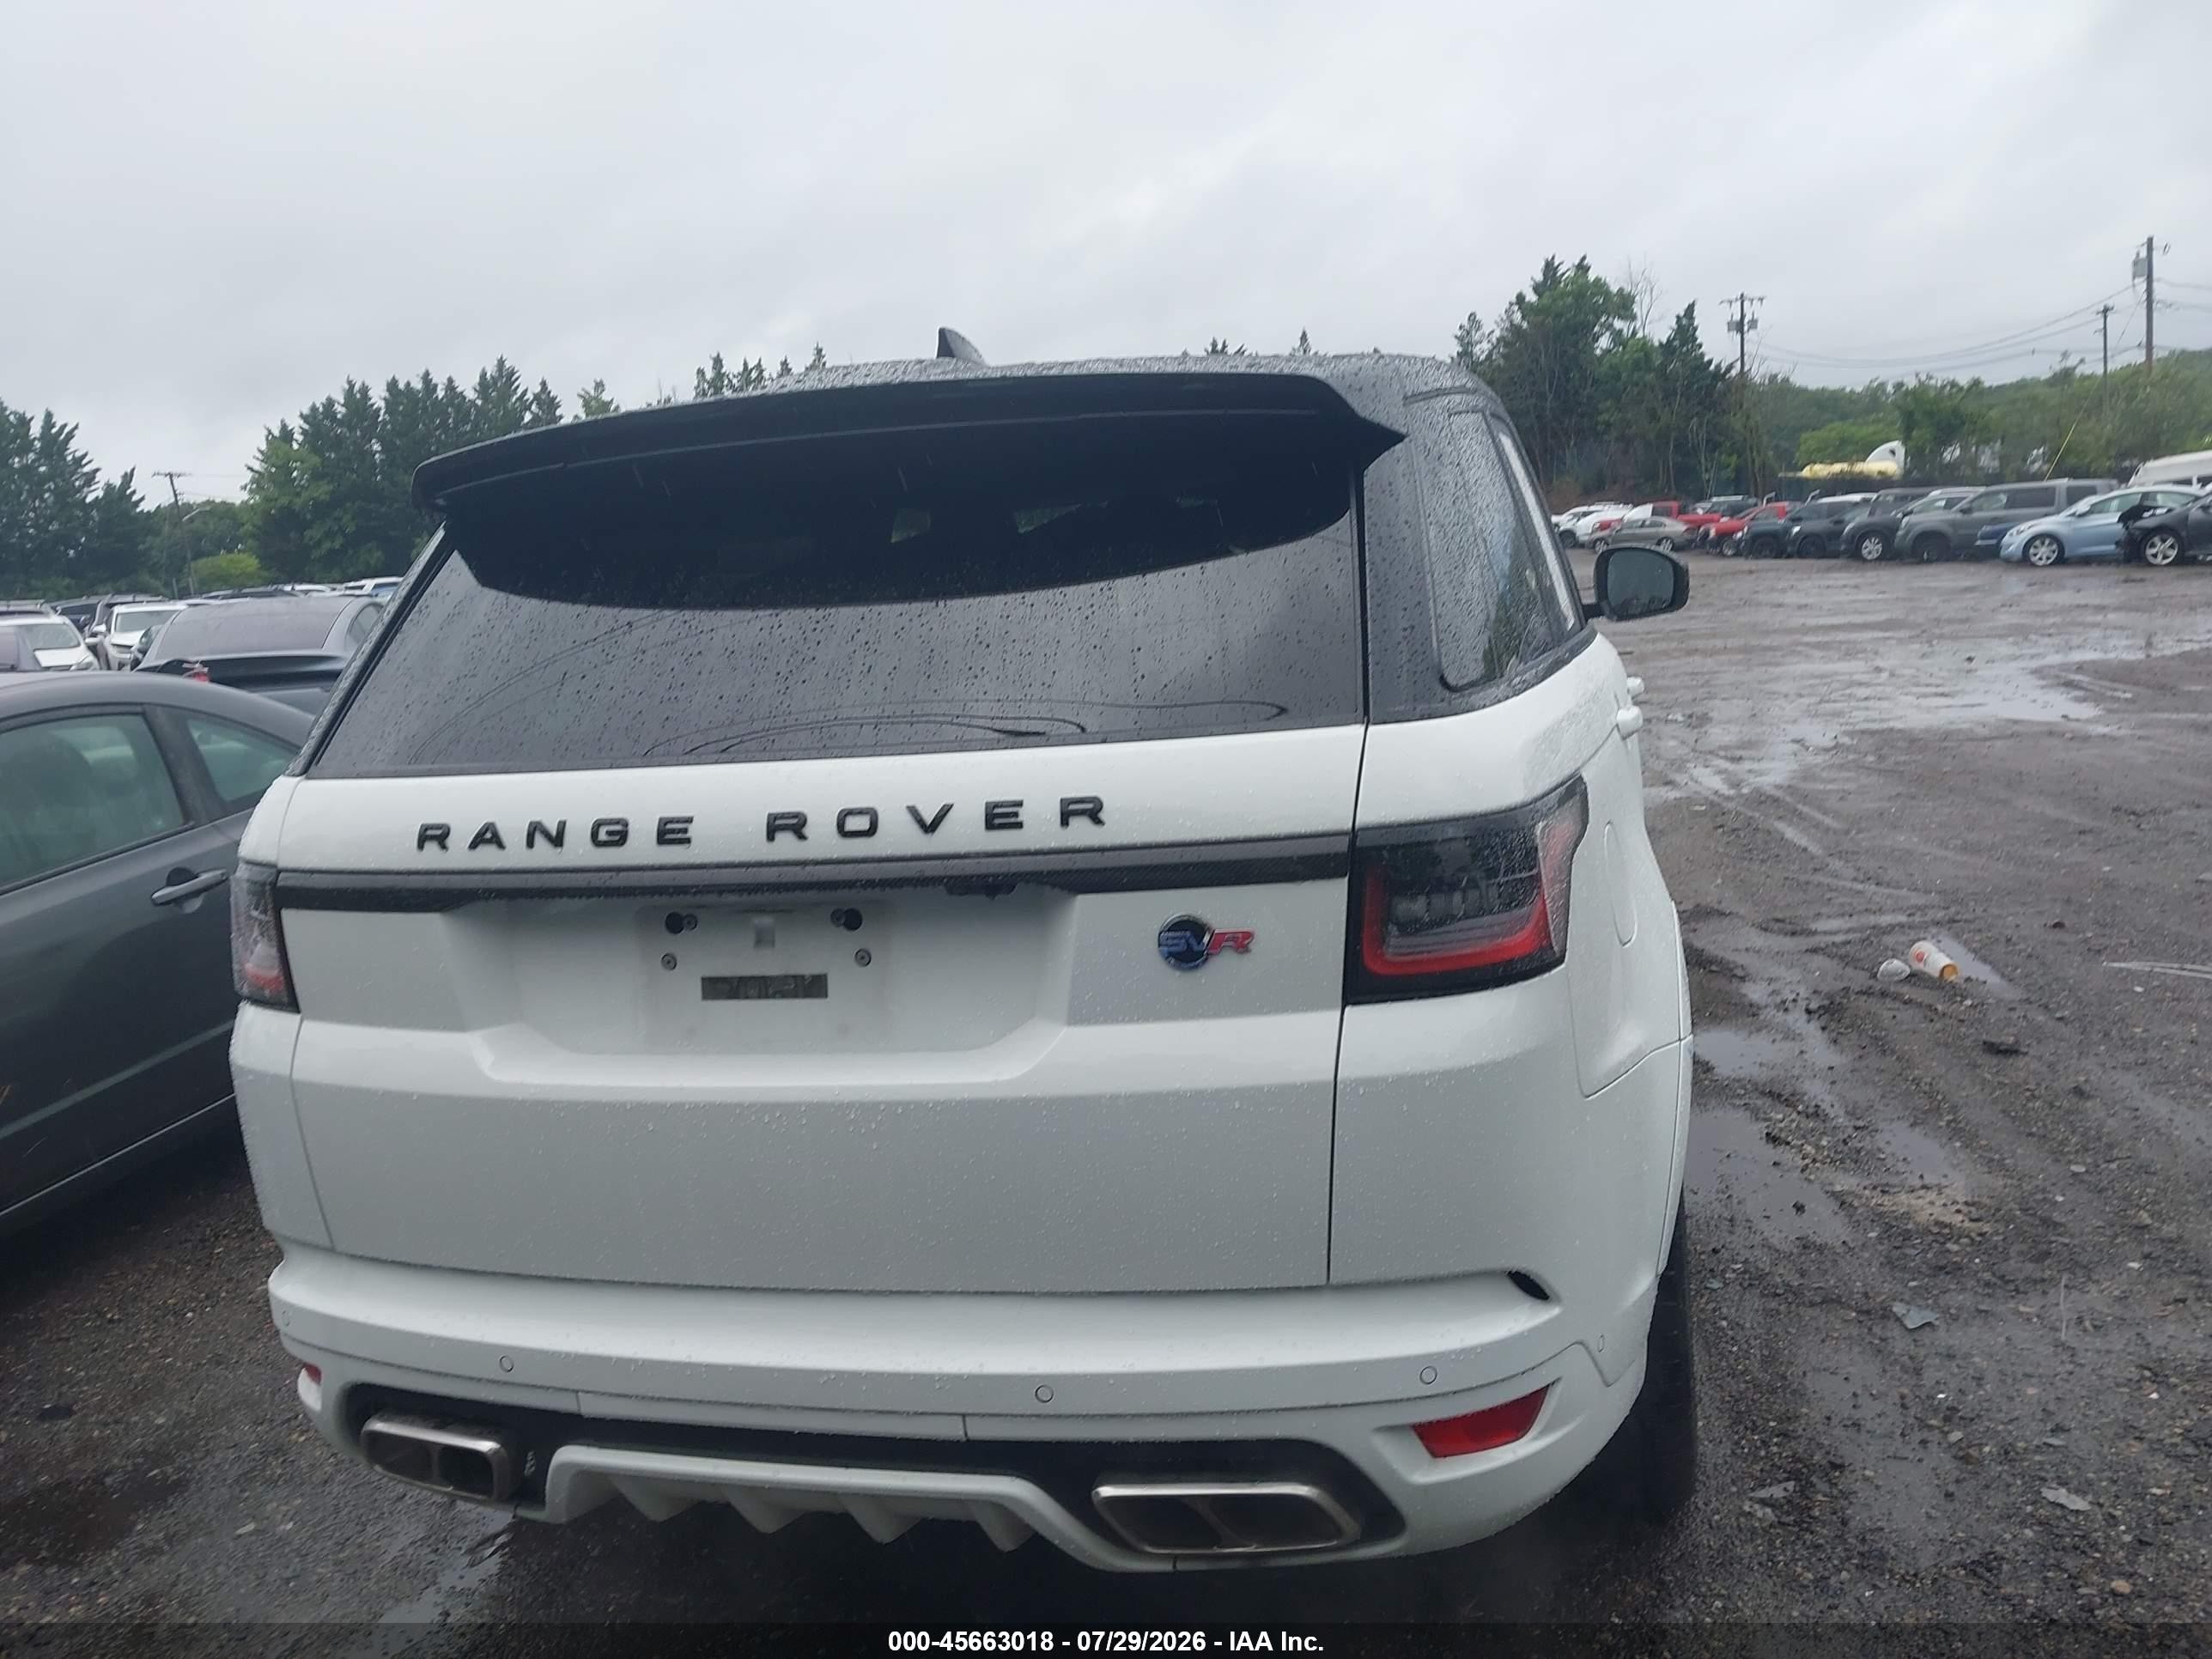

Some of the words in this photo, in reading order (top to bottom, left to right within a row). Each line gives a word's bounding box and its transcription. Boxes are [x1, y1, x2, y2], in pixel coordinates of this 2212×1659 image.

[416, 816, 694, 853] RANGE
[765, 796, 1106, 843] ROVER
[1158, 927, 1255, 957] SVR
